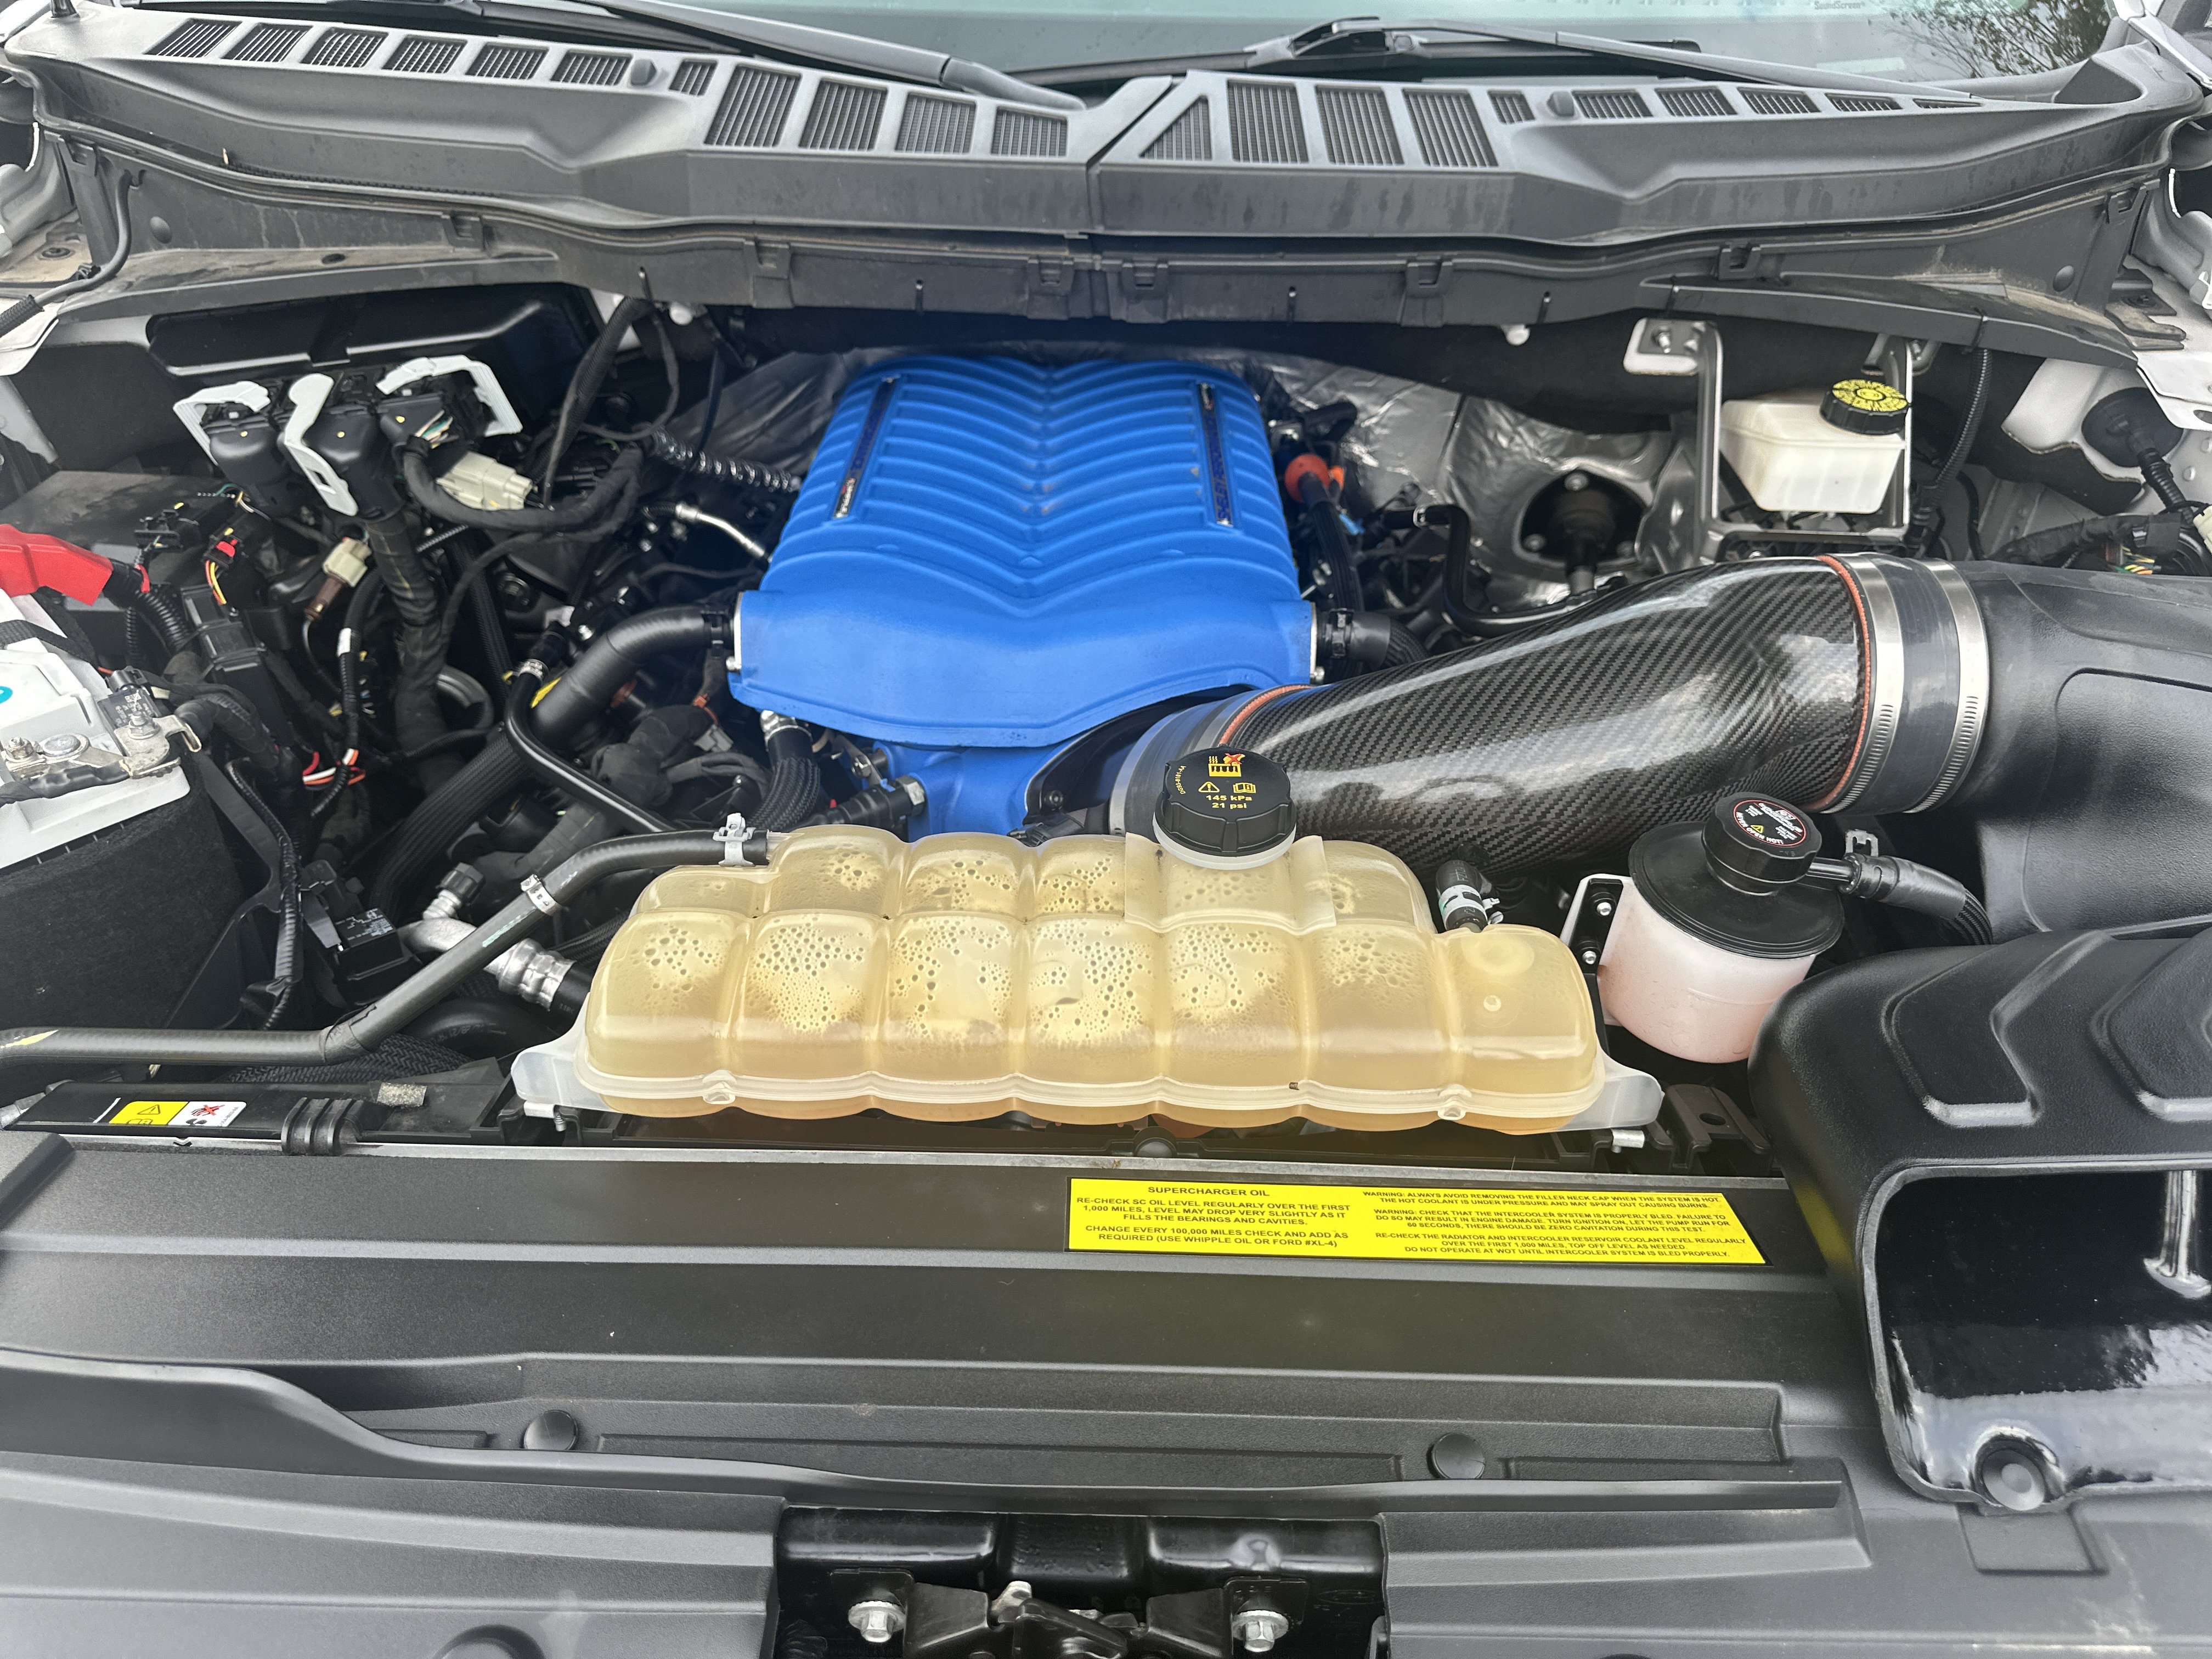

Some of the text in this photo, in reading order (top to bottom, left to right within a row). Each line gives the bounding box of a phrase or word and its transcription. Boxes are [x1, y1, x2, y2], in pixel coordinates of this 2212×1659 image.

[1746, 827, 1765, 839] OPEN
[1148, 1186, 1246, 1196] SUPERCHARGER
[1156, 1235, 1181, 1243] (USE
